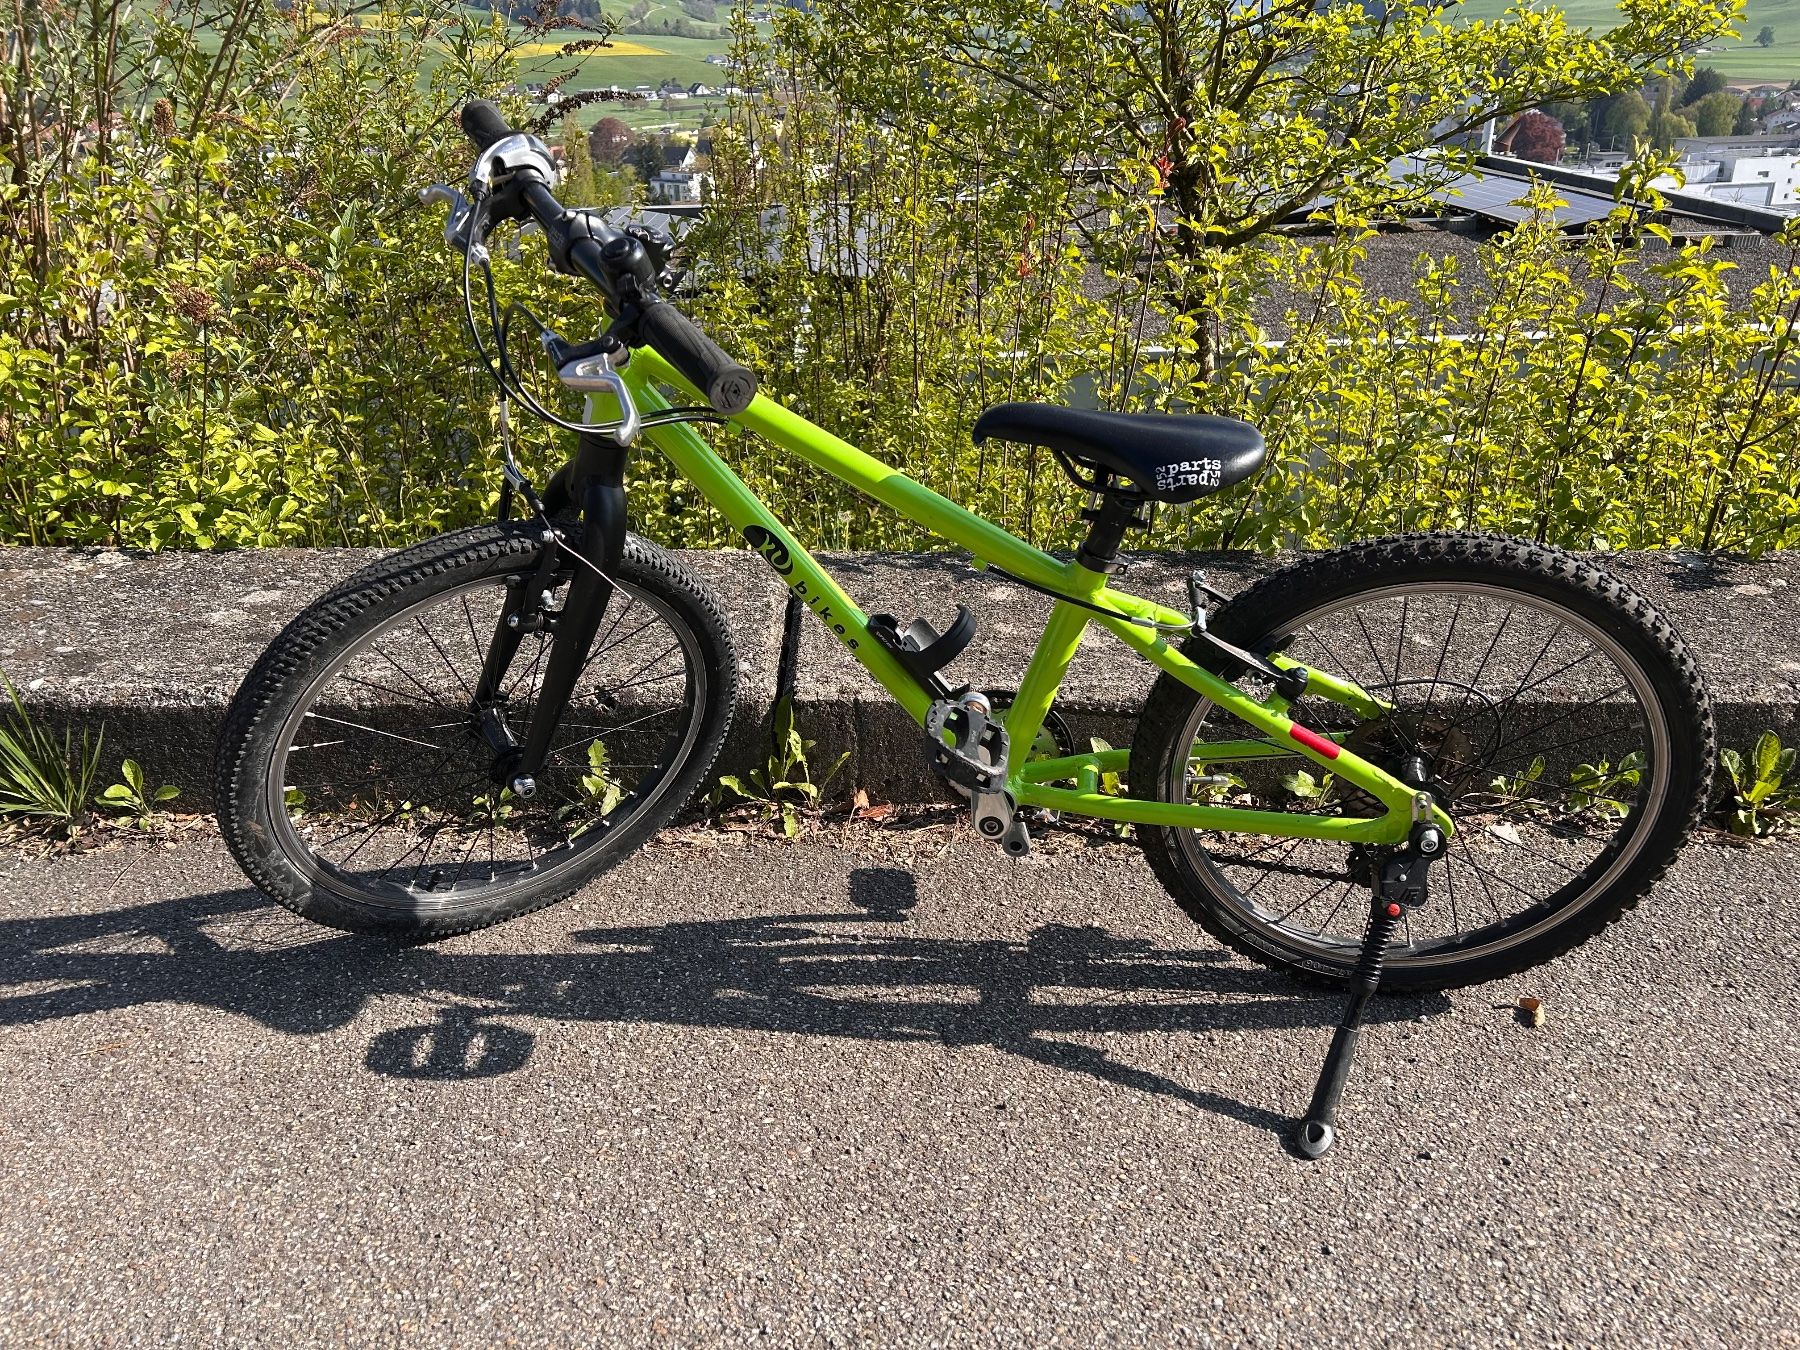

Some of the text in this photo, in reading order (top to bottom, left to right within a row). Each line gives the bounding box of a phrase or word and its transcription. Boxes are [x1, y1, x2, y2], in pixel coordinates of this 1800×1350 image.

[1167, 457, 1221, 477] parts
[1157, 470, 1209, 491] parts
[794, 580, 860, 650] bikes
